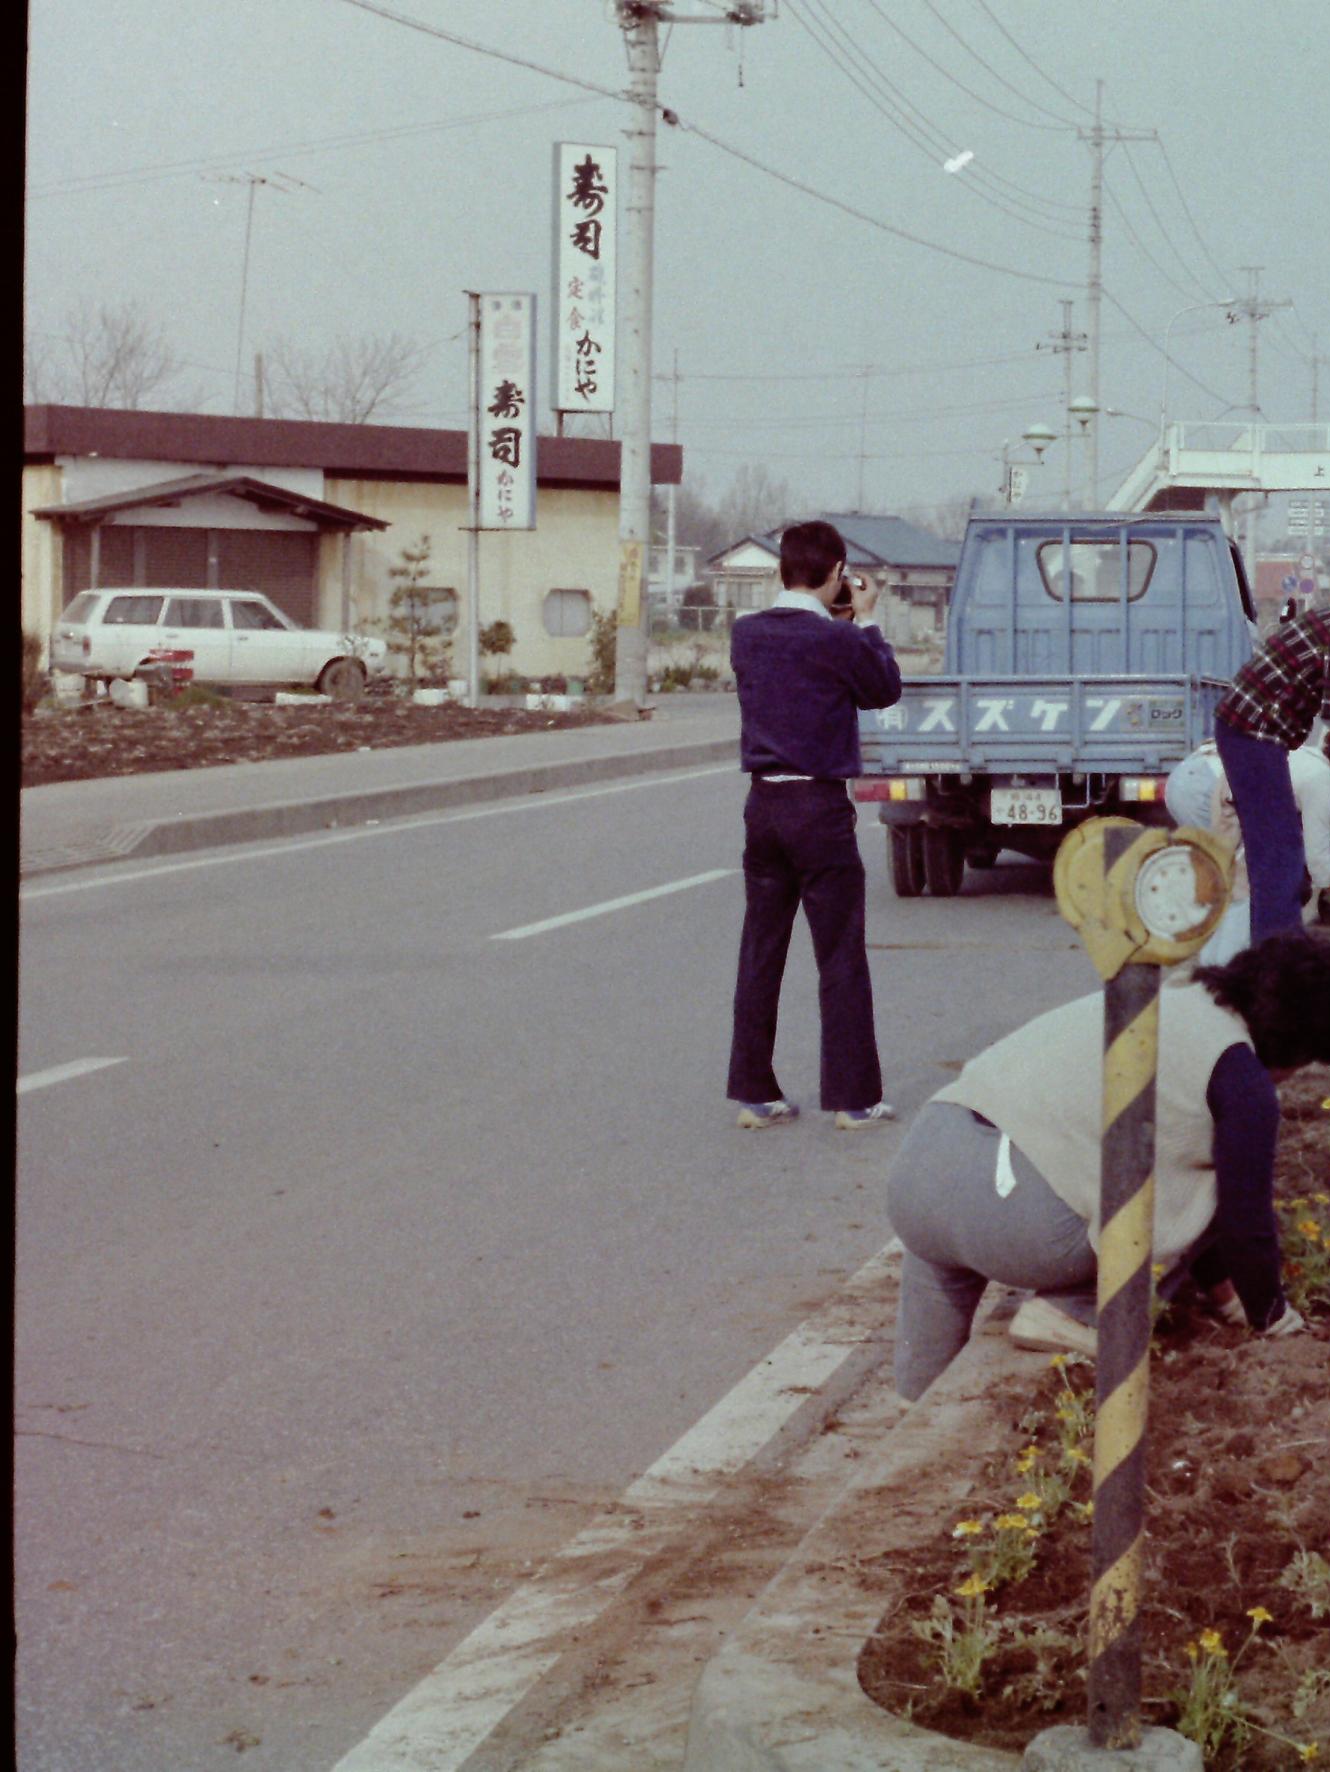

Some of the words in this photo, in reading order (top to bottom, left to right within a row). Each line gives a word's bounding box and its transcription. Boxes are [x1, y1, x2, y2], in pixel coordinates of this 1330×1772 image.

[566, 153, 608, 260] 寿司
[567, 276, 585, 330] 定食
[575, 330, 602, 402] かにや
[487, 380, 526, 469] 寿司
[497, 470, 514, 523] かにや
[1007, 804, 1058, 821] 48-96
